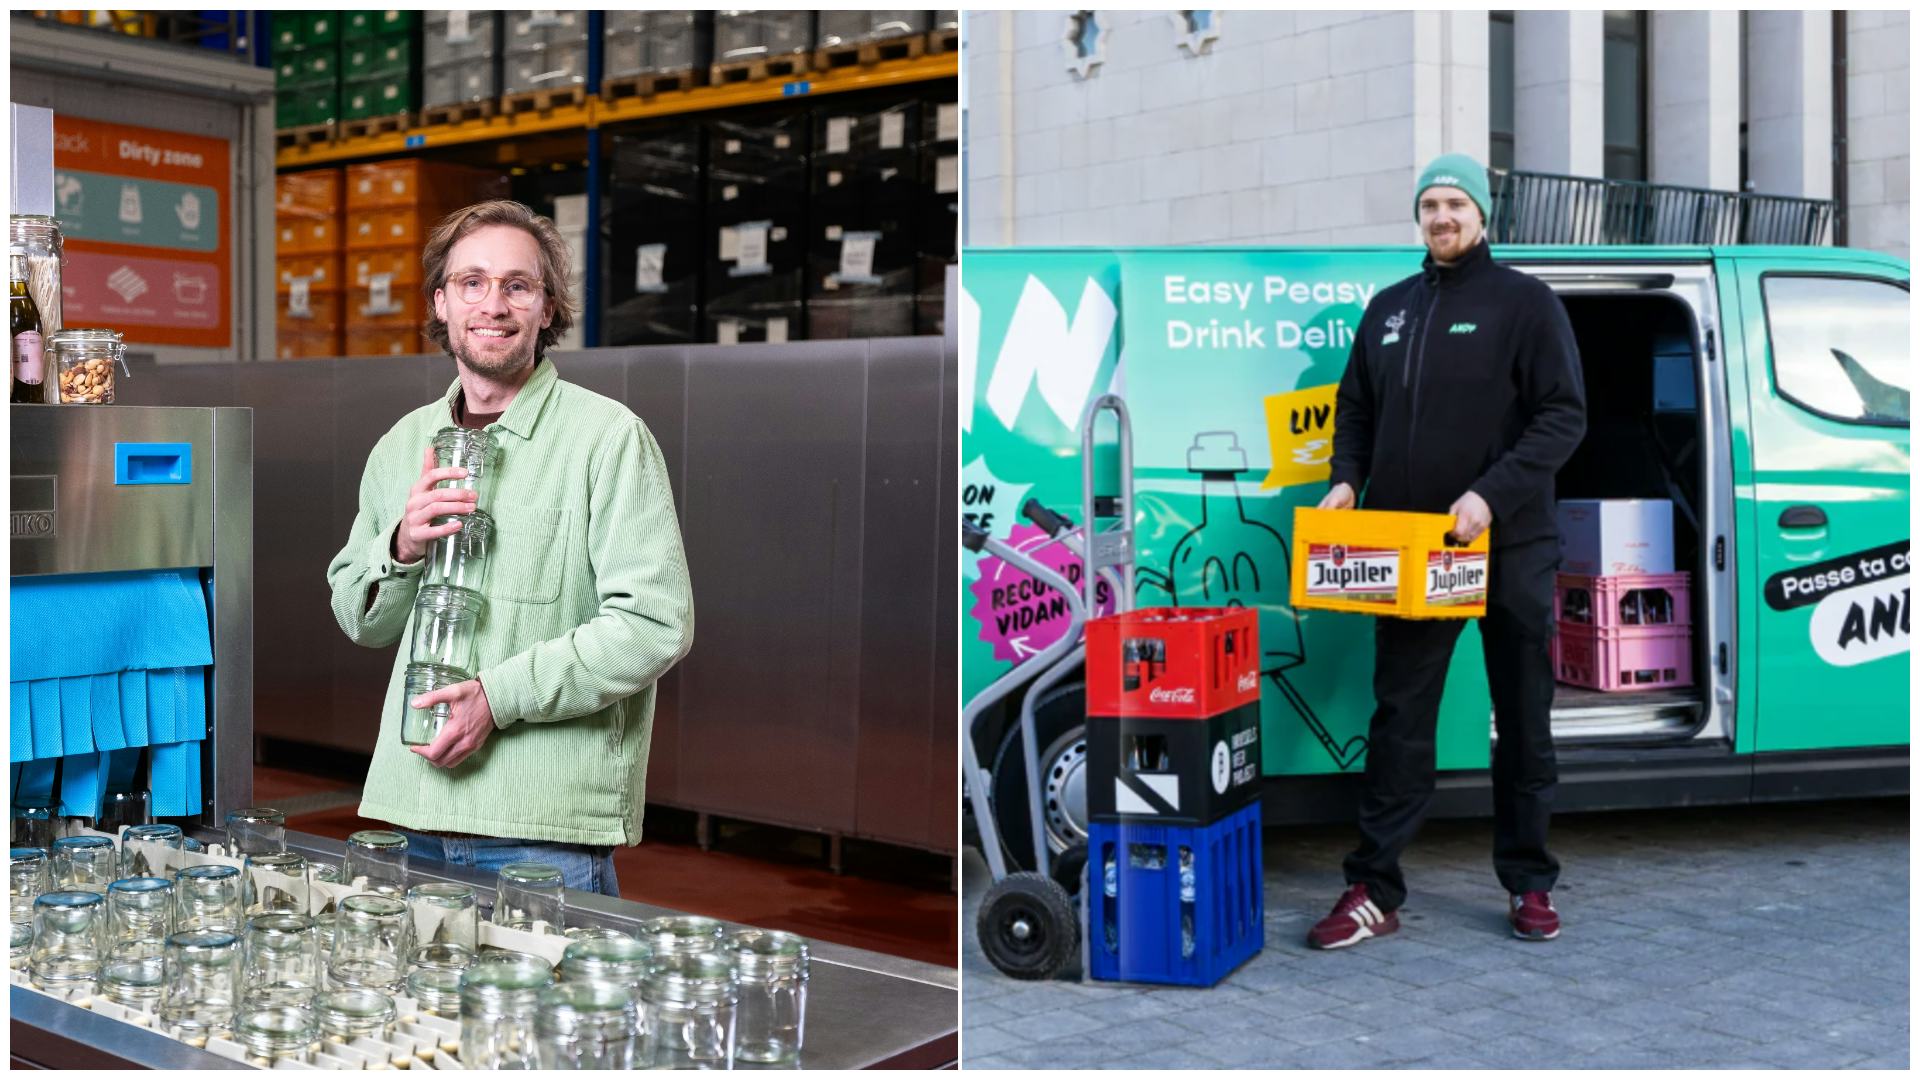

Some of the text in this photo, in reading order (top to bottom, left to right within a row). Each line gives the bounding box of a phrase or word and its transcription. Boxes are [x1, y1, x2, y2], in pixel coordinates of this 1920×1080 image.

[118, 139, 204, 169] Dirty zone
[1164, 274, 1376, 310] Easy Peasy
[1167, 320, 1267, 348] Drink
[1276, 318, 1356, 348] Deliv
[1290, 403, 1331, 435] LIV
[1313, 561, 1393, 589] Jupiler
[1430, 565, 1484, 593] Jupiler
[1781, 550, 1910, 600] Passe ta c
